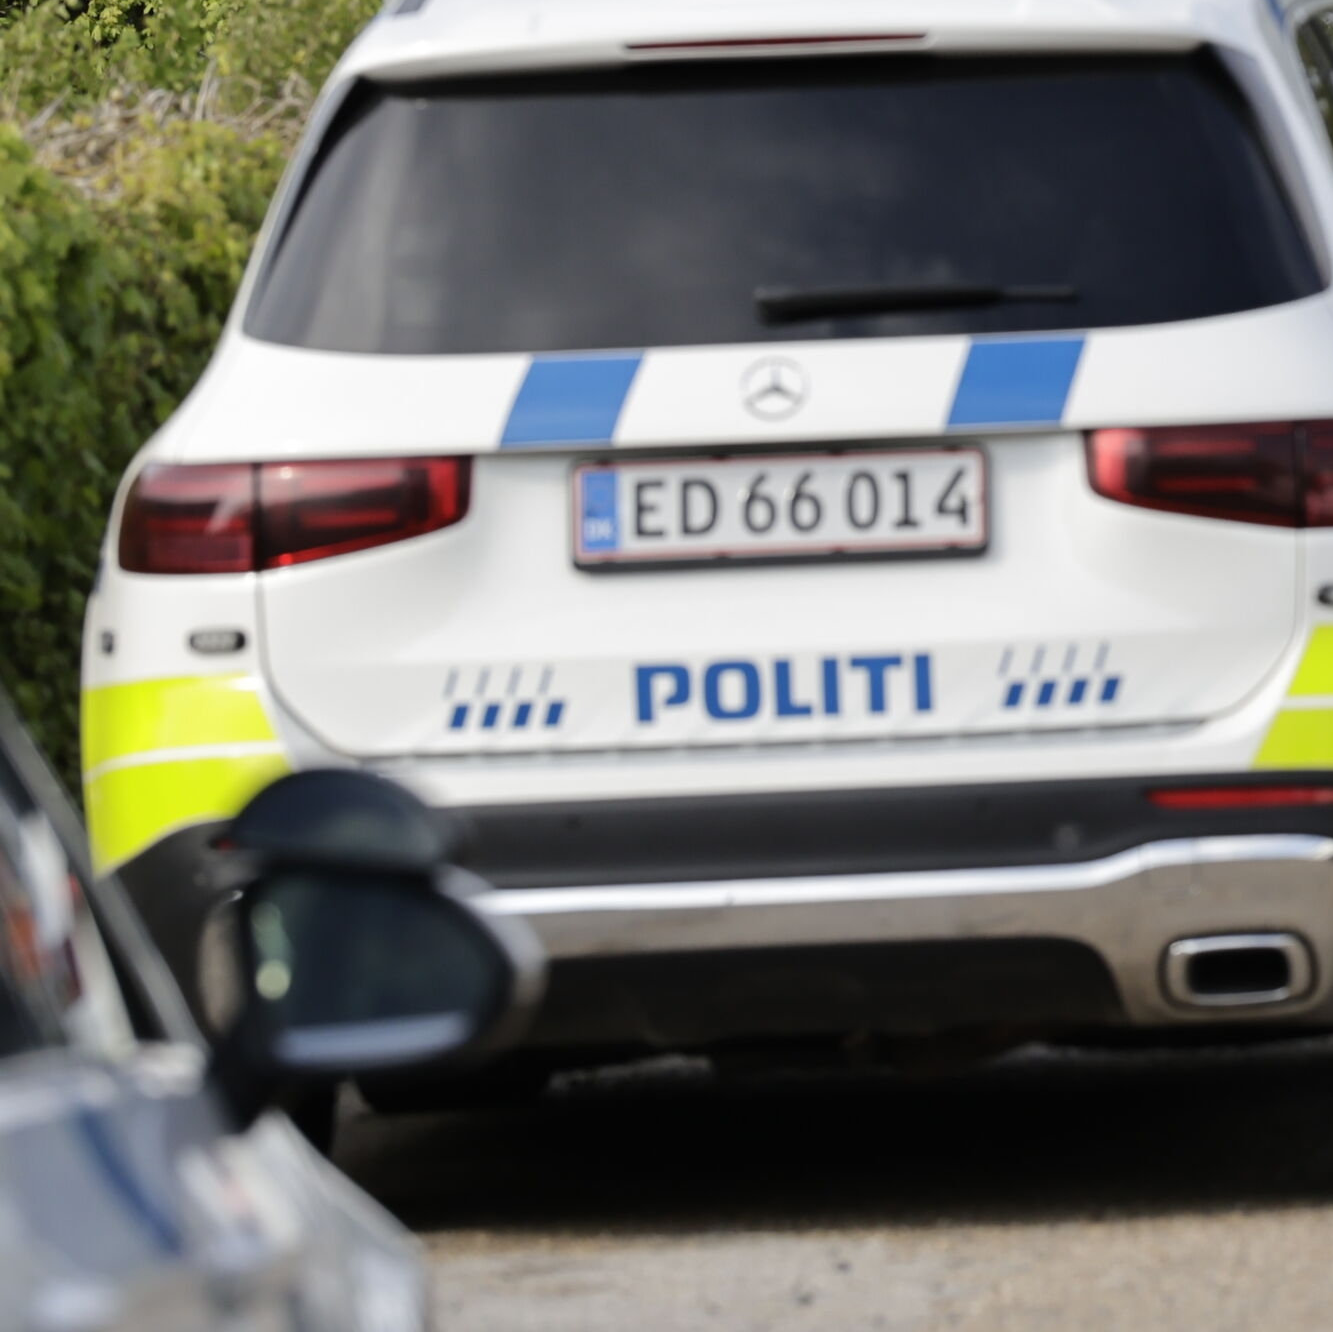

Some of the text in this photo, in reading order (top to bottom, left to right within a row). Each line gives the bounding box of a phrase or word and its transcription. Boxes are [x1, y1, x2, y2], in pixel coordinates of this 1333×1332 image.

[634, 467, 970, 538] ED 66 014
[634, 653, 932, 723] POLITI
